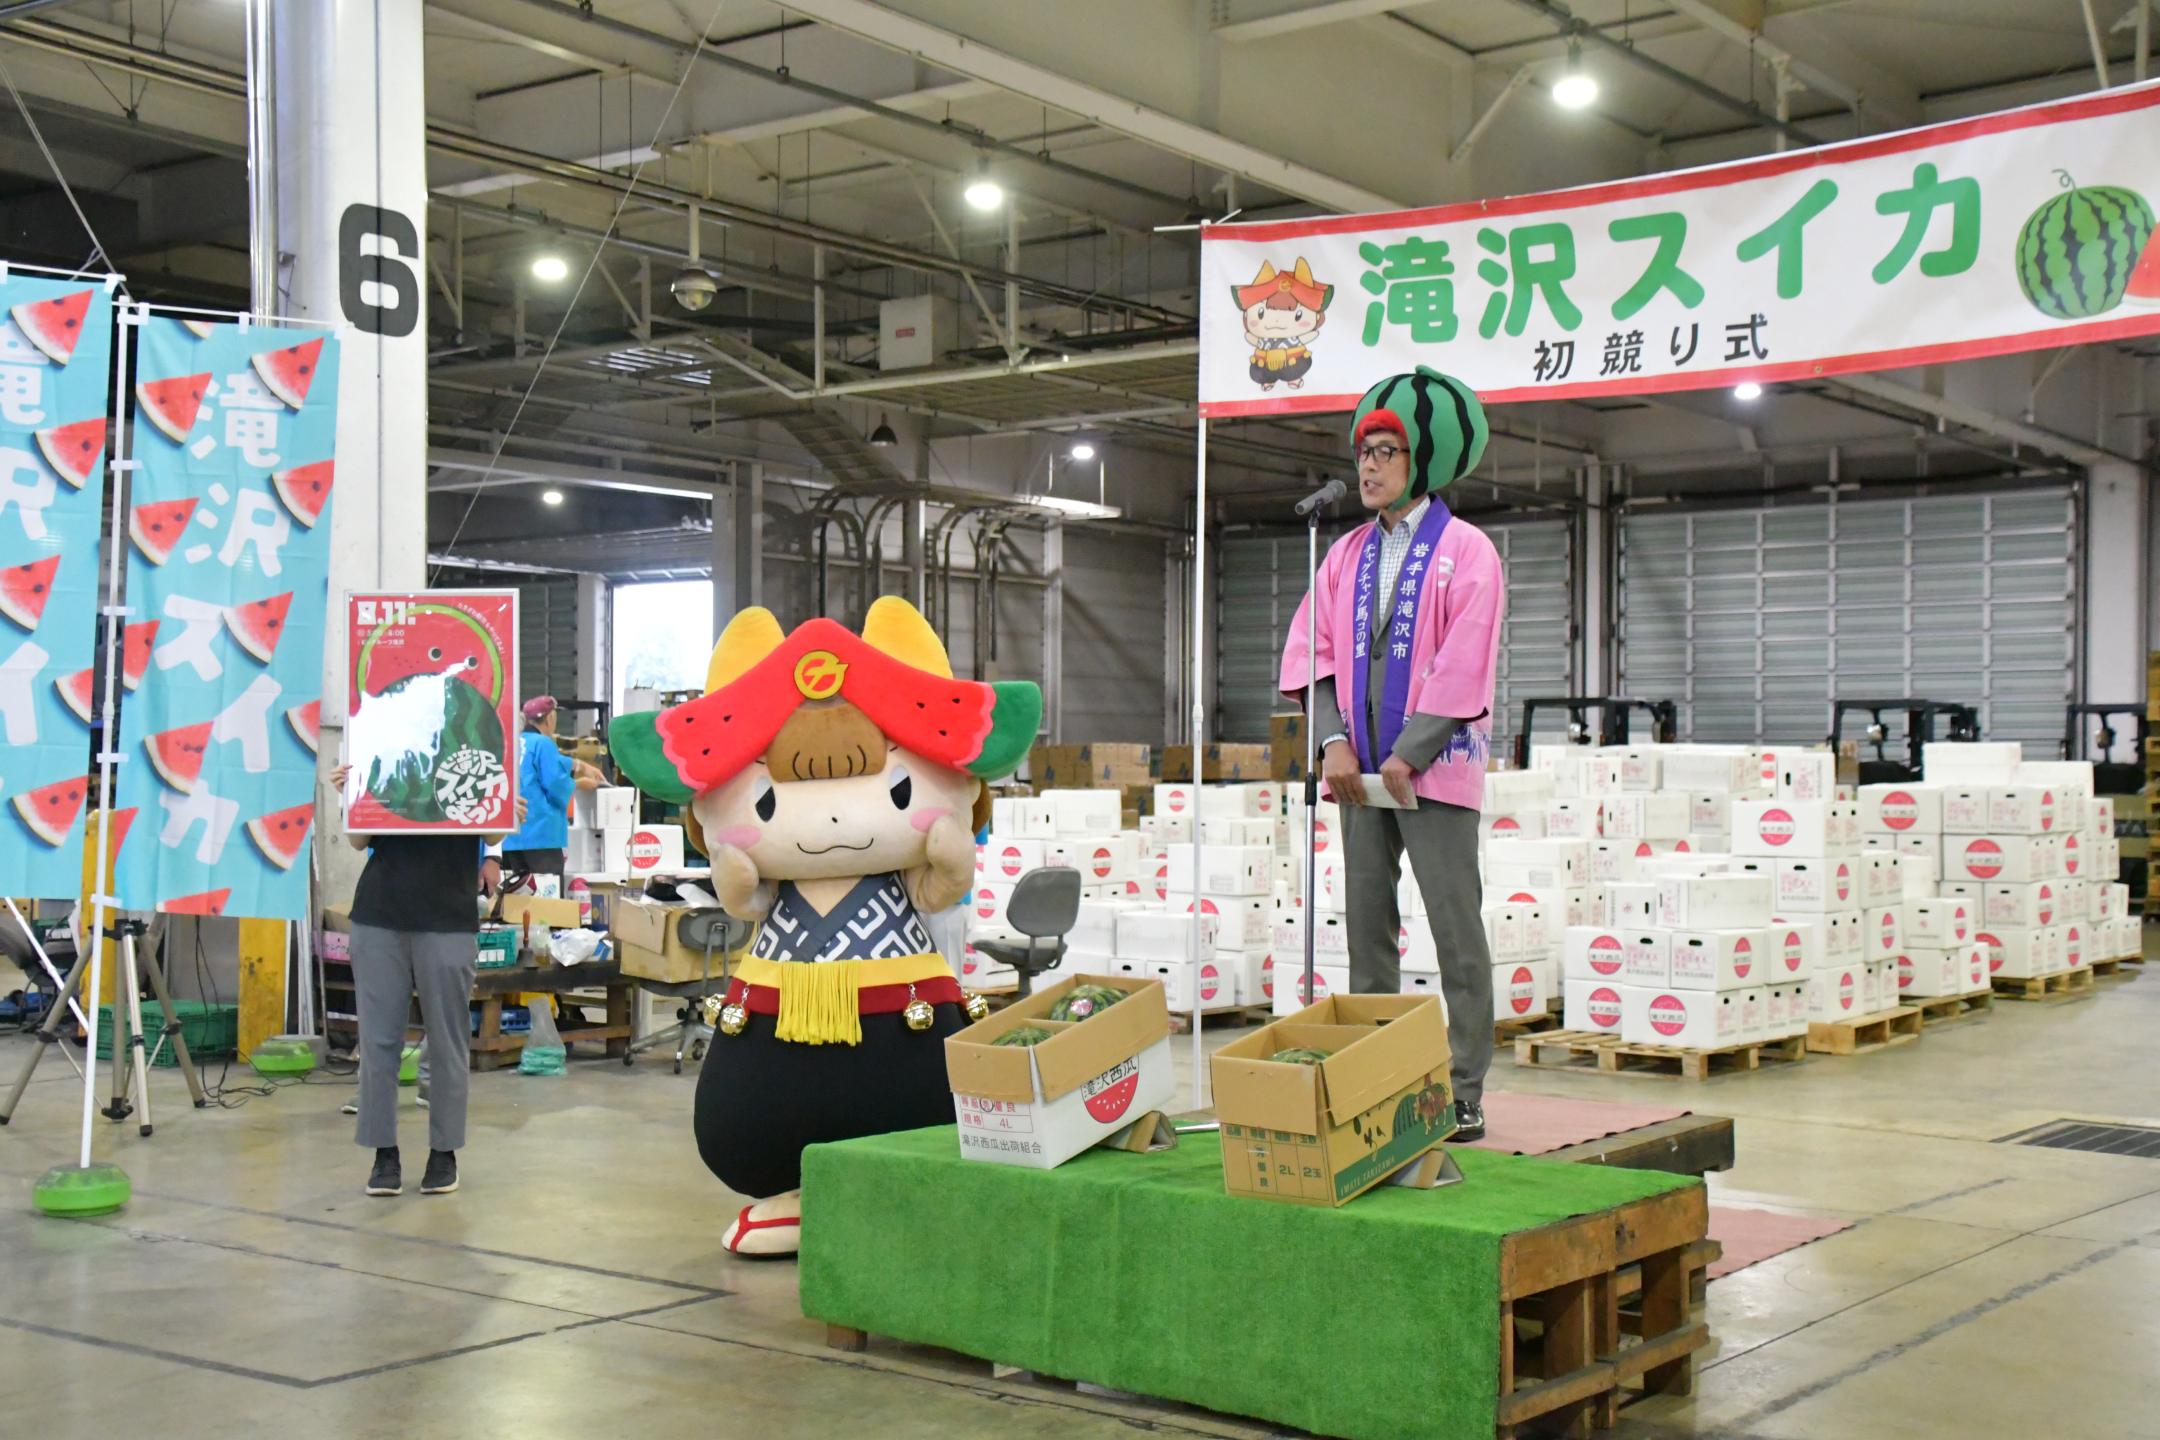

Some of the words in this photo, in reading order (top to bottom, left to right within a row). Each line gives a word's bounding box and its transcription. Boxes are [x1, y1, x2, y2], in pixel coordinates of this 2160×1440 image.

[338, 203, 420, 337] 6
[1359, 161, 1982, 347] 滝沢スイカ
[1533, 313, 1770, 383] 初競り式
[155, 369, 289, 866] 滝沢スイカ
[1354, 542, 1377, 659] チャグチャグ馬コの里
[1391, 542, 1430, 660] 岩手県滝沢市
[1081, 1056, 1138, 1097] 滝沢西瓜
[961, 1134, 1042, 1154] 滝沢西瓜出荷組合
[999, 1118, 1013, 1129] 4L
[1279, 1164, 1296, 1177] 2L
